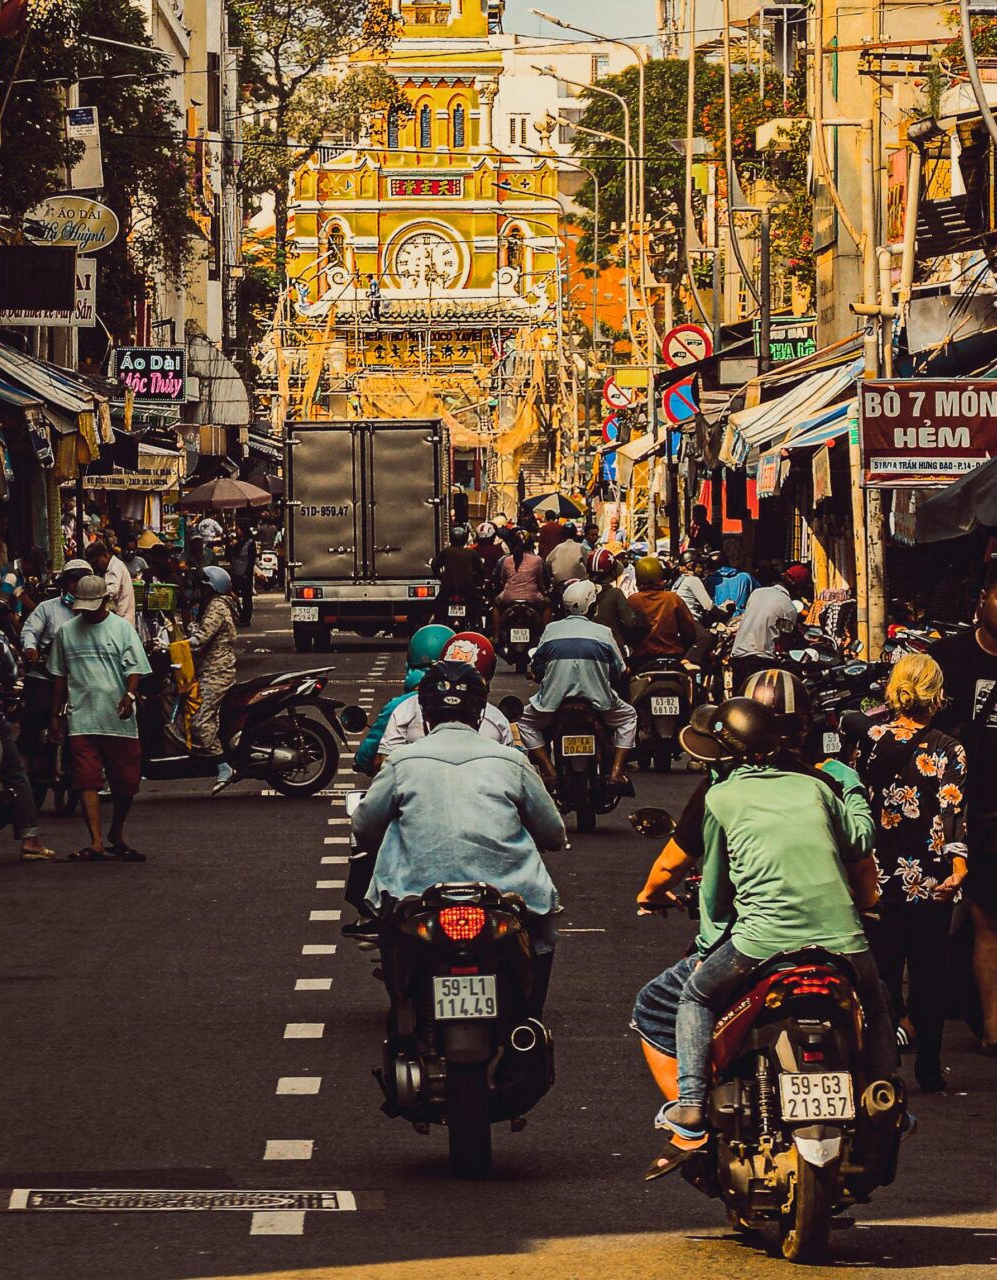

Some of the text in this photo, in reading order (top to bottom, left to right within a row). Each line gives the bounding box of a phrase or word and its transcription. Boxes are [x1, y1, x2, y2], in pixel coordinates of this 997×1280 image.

[120, 351, 181, 370] Áo Dài
[864, 385, 997, 418] BÒ 7 MÓN
[894, 419, 971, 448] HẺM
[441, 978, 487, 997] 59-L1
[436, 997, 495, 1017] 114.49
[790, 1075, 842, 1096] 59-G3
[787, 1096, 848, 1119] 213.57
